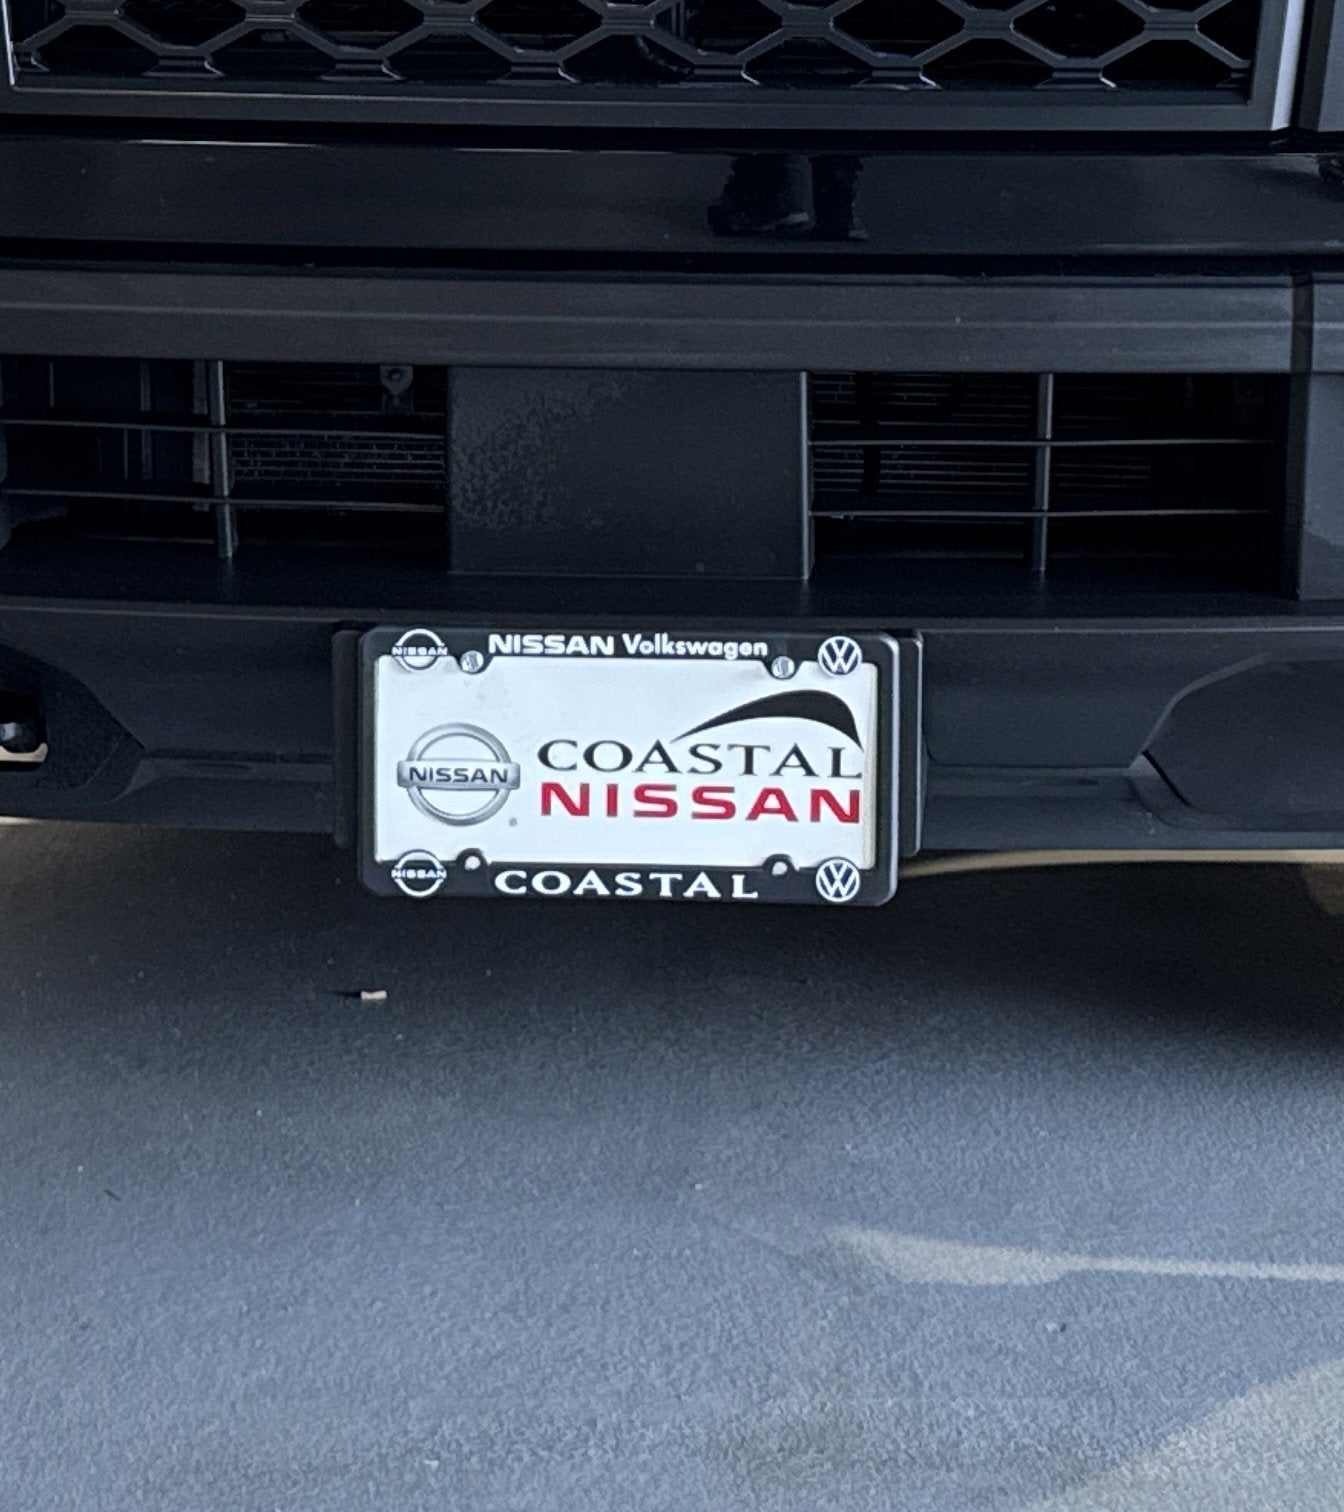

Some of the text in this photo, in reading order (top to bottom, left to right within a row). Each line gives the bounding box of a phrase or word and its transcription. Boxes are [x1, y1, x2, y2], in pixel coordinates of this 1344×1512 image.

[488, 632, 768, 660] NISSAN Volkswagen
[537, 739, 863, 779] COASTAL
[409, 765, 509, 784] NISSAN
[541, 781, 861, 825] NISSAN
[494, 869, 759, 899] COASTAL
